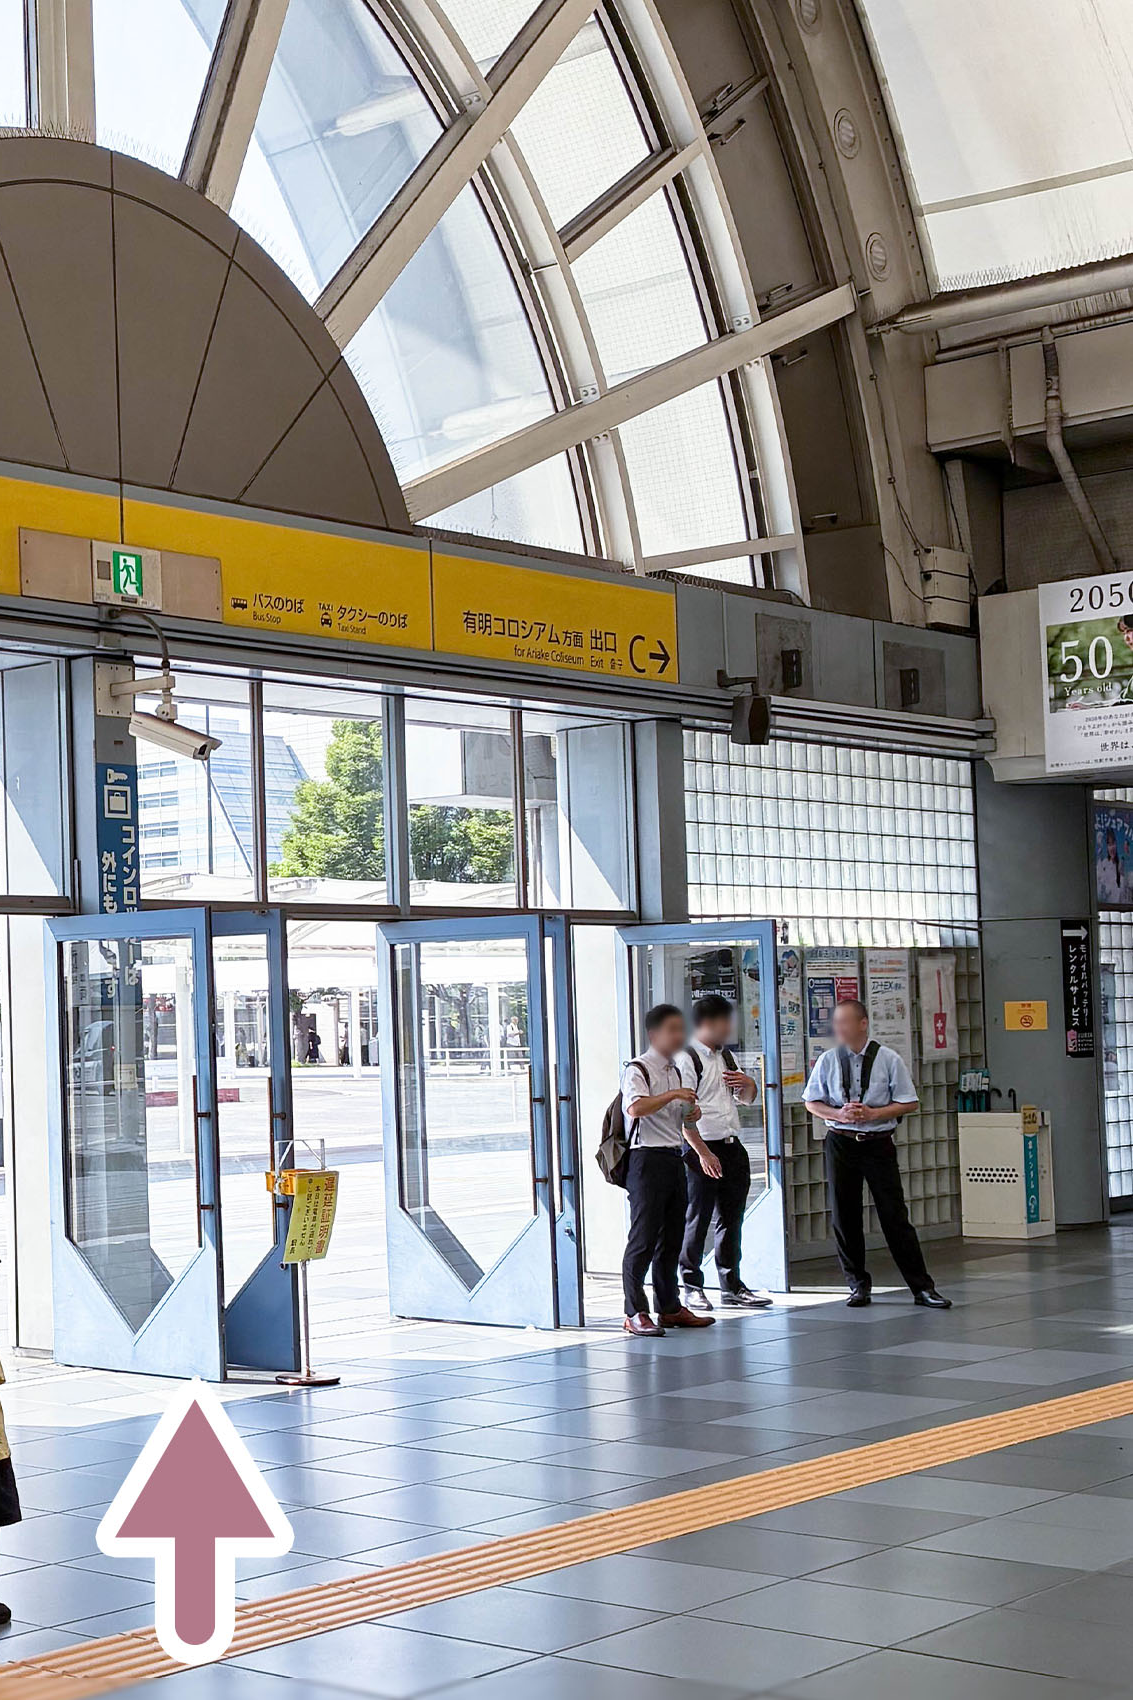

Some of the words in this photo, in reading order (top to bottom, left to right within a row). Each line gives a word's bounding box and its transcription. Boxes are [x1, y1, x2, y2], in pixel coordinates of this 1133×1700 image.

[253, 593, 305, 614] バスのりば
[318, 602, 334, 611] TAXI
[253, 611, 265, 622] Bus
[266, 613, 281, 625] Stop
[336, 605, 408, 629] タクシーのりば
[337, 623, 348, 633] Taxi
[349, 624, 366, 635] Stand
[463, 610, 584, 649] 有明コロシアム方面
[590, 628, 617, 653] 出口
[514, 644, 525, 657] for
[527, 647, 549, 661] Ariake
[551, 650, 584, 665] Coliseum
[591, 656, 604, 668] Exit
[629, 634, 645, 674] C
[1060, 636, 1113, 683] 50
[1064, 686, 1094, 697] Years
[1097, 682, 1112, 693] old
[1069, 944, 1080, 1027] レンタルサービス
